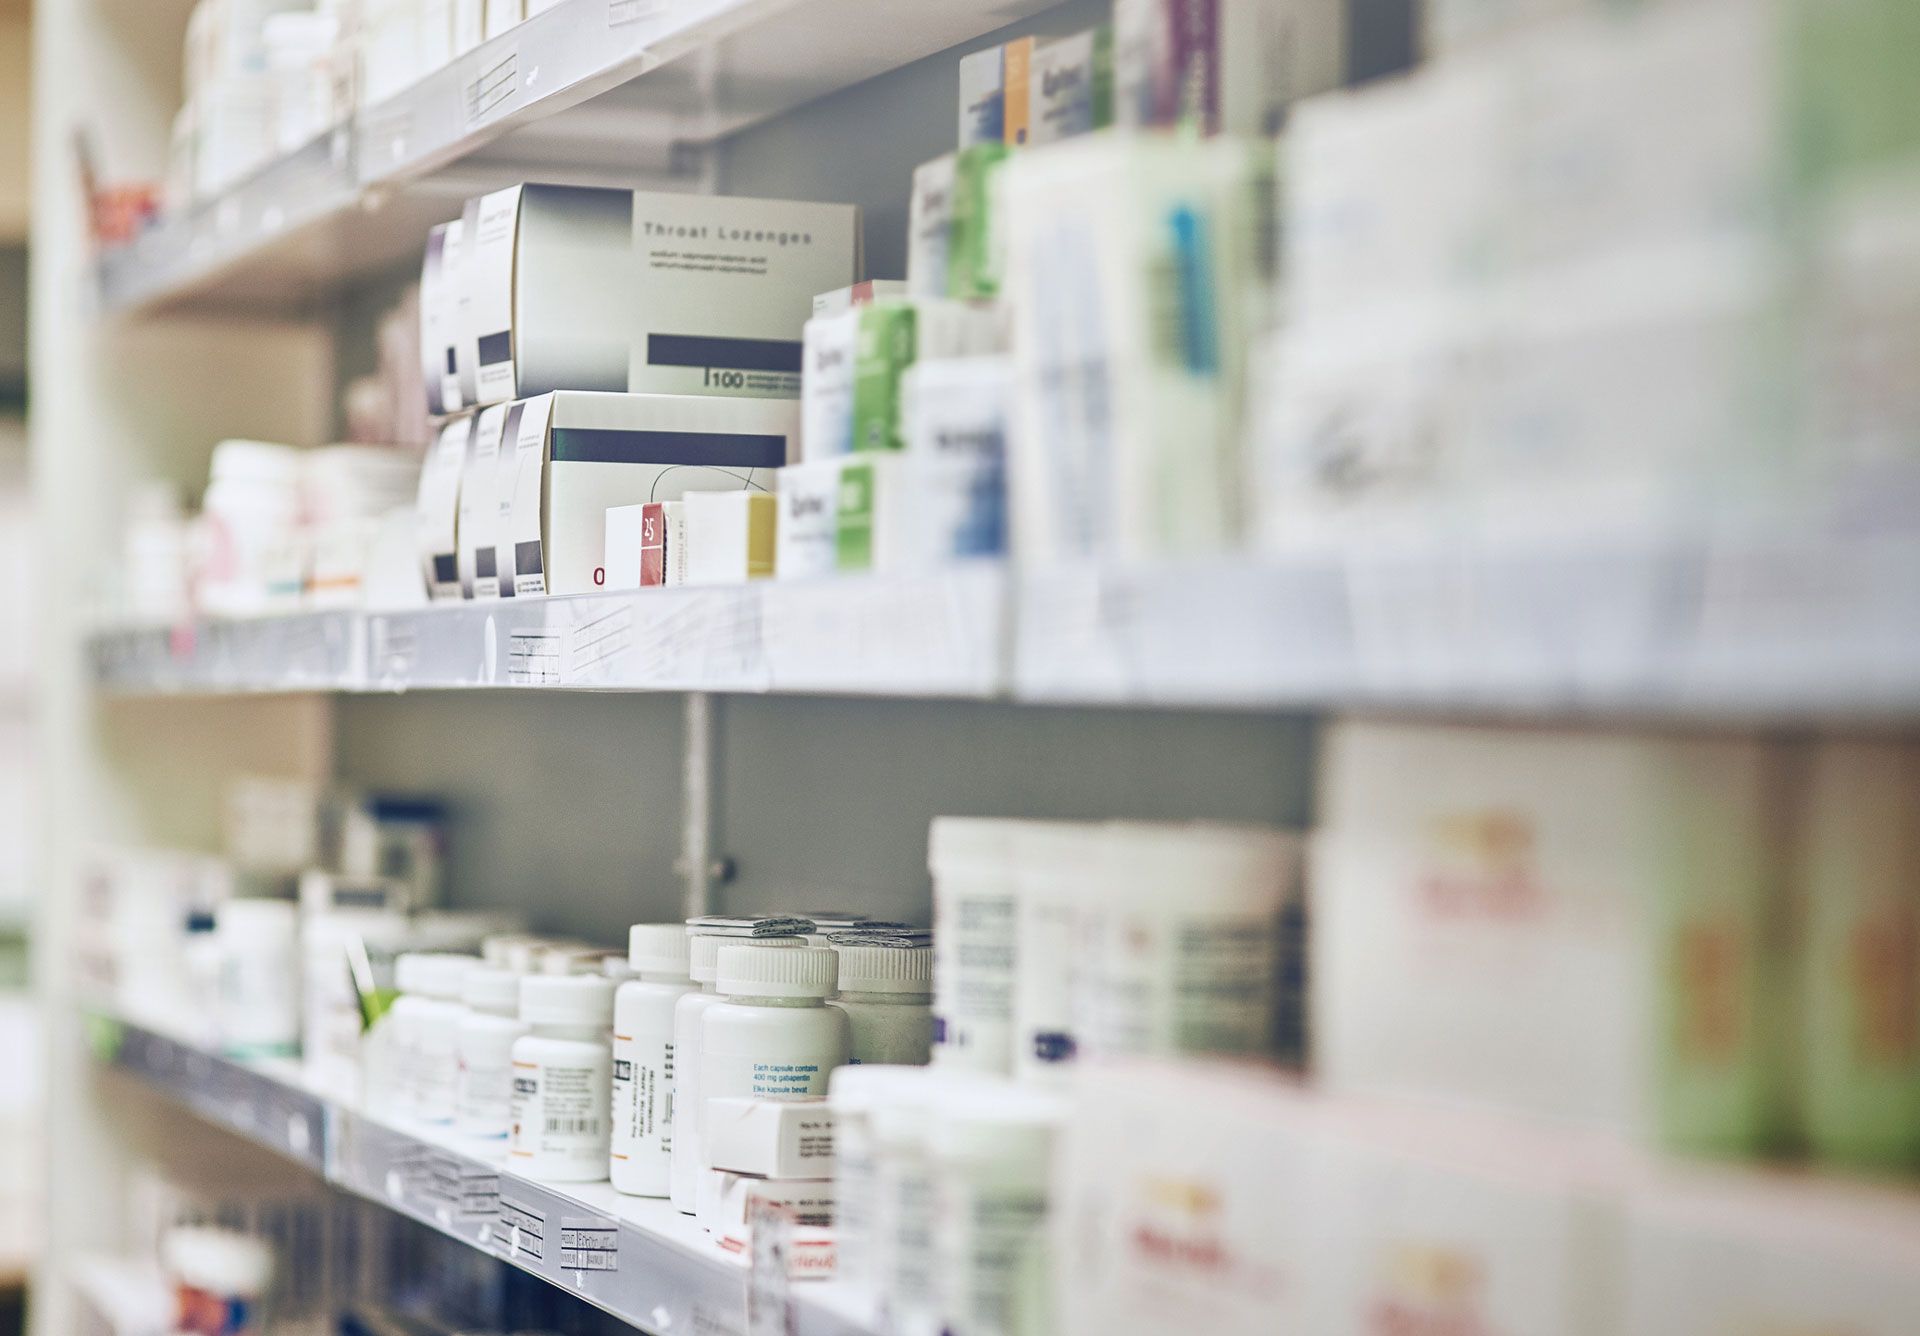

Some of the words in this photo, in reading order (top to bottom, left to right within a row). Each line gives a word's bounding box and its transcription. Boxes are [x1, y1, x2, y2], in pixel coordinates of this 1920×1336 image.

[645, 222, 707, 239] Throat
[718, 226, 812, 246] Lozenges
[713, 370, 744, 389] 100
[644, 517, 654, 541] 25
[753, 1063, 768, 1072] Each
[770, 1064, 793, 1073] capsule
[795, 1064, 818, 1072] contains
[753, 1073, 765, 1081] 400
[767, 1074, 777, 1082] mg
[779, 1074, 810, 1082] gabapentin
[767, 1085, 790, 1093] kapsule
